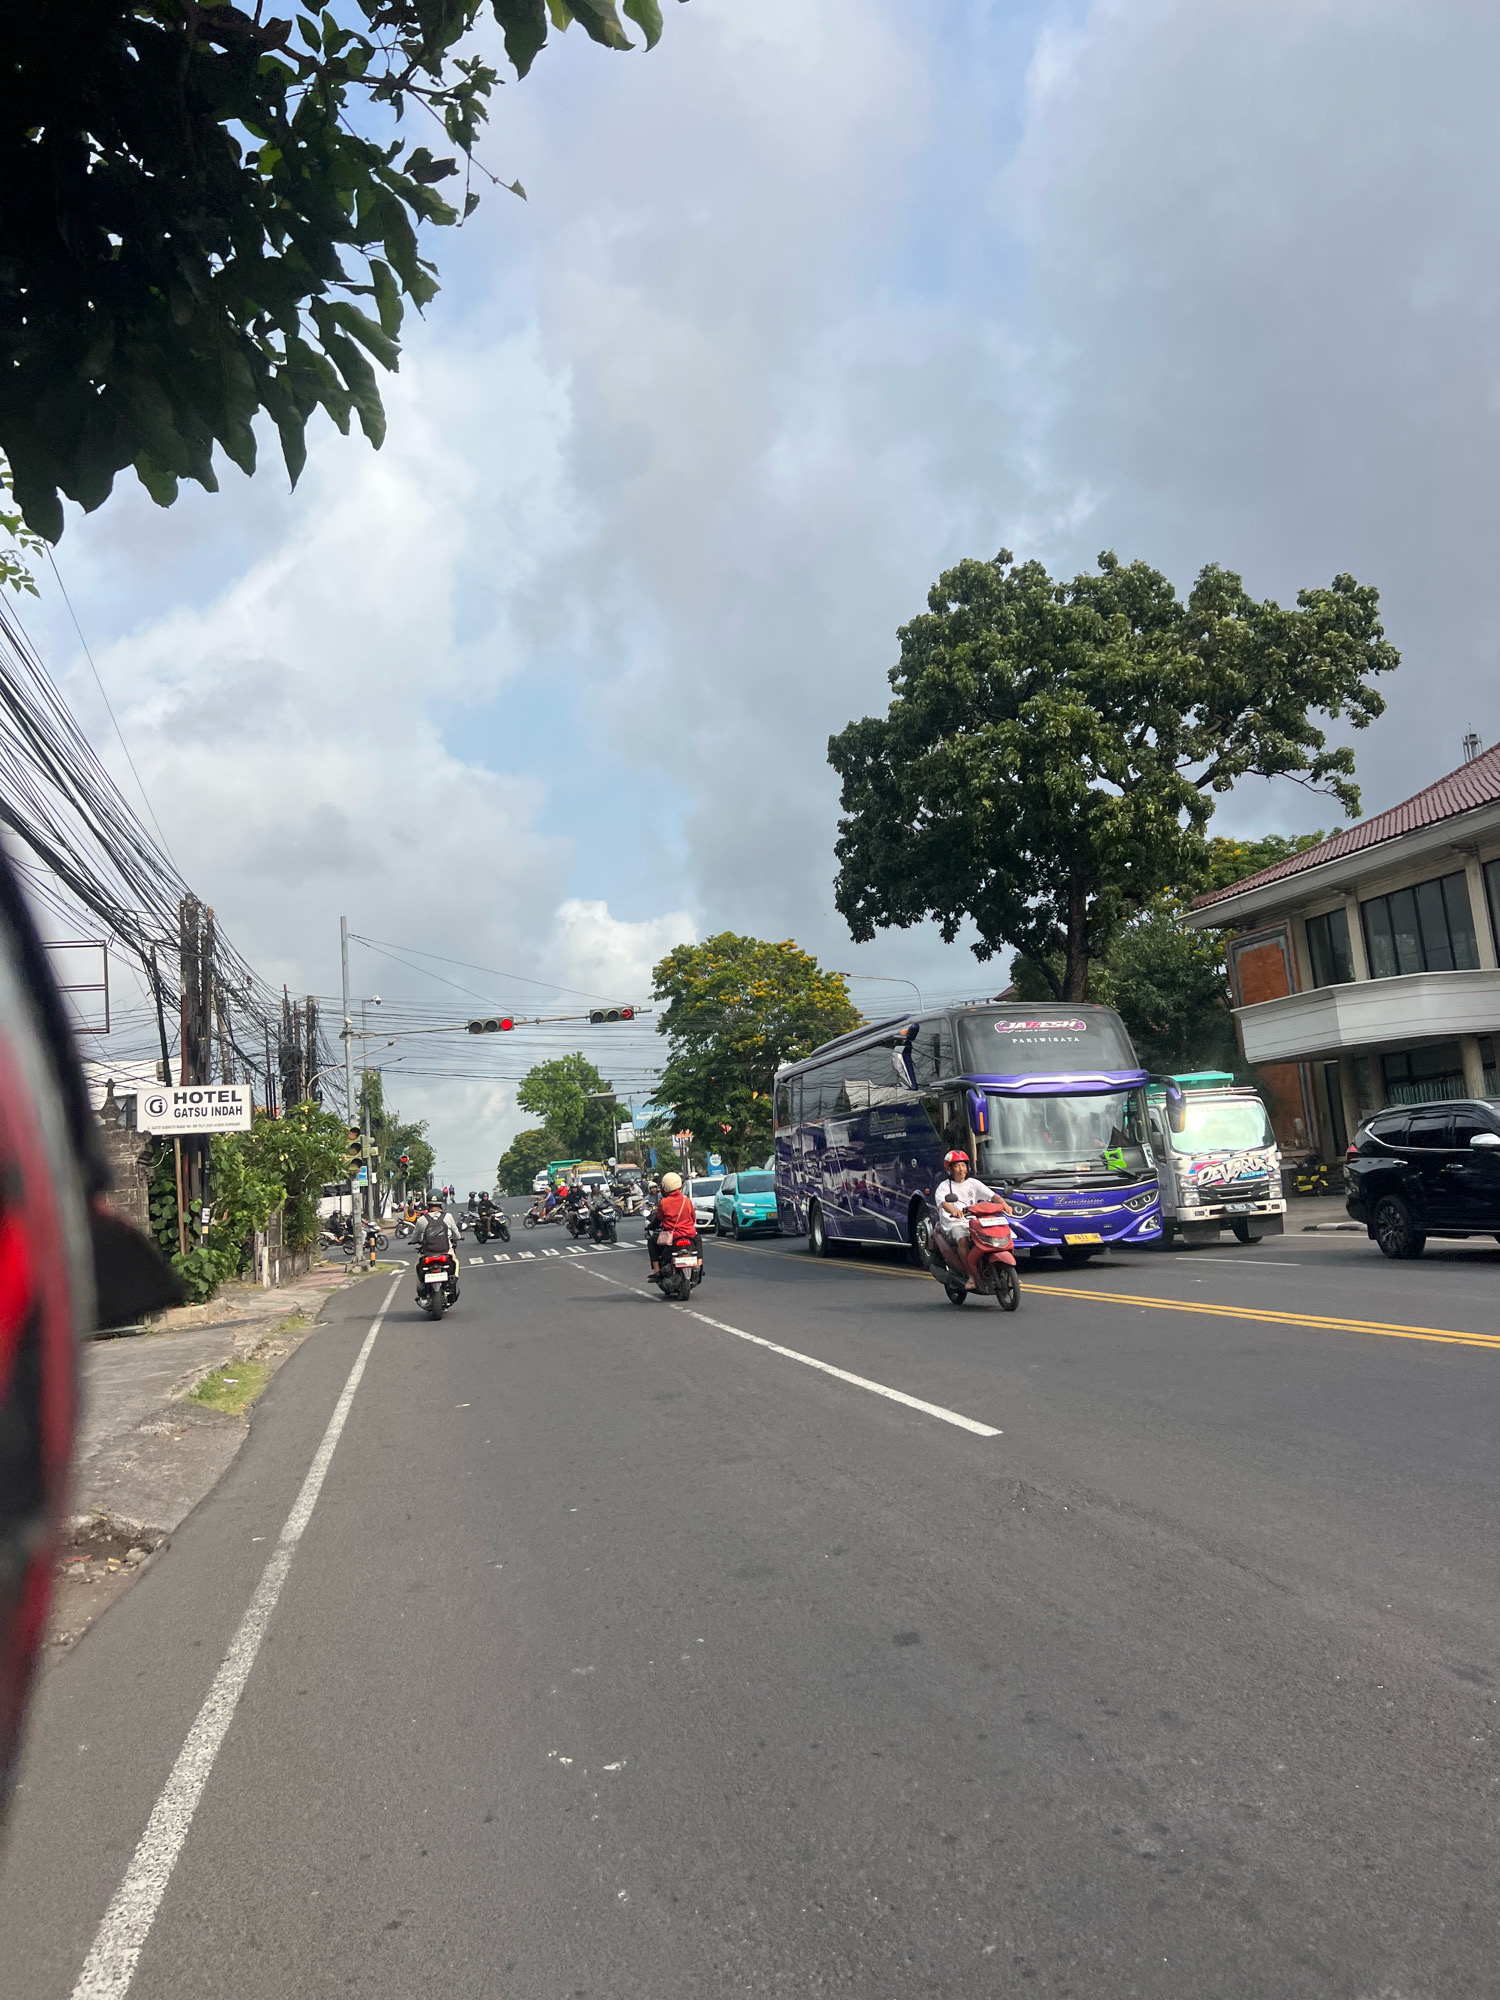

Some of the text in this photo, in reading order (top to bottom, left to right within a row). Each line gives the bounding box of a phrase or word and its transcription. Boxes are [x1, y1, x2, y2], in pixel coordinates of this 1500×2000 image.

[1012, 1036, 1080, 1044] PARIWISATA
[173, 1090, 243, 1104] HOTEL
[174, 1105, 243, 1118] GATSU INDAH
